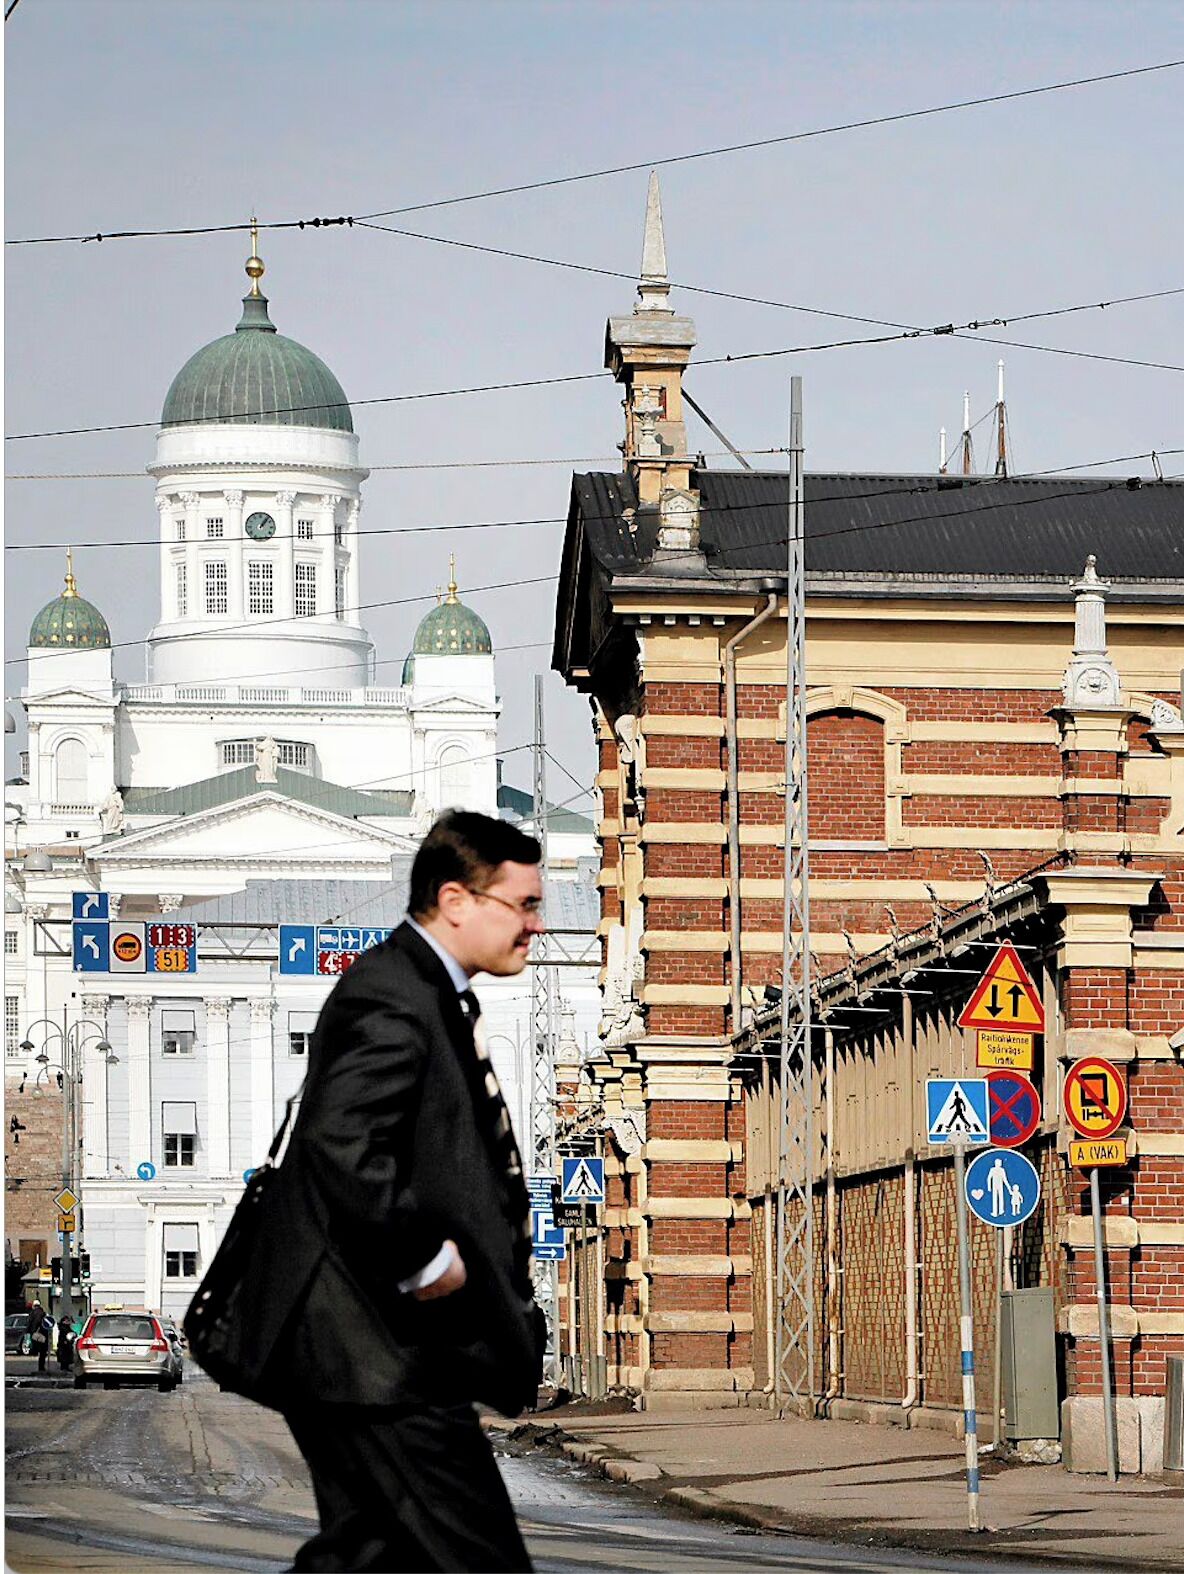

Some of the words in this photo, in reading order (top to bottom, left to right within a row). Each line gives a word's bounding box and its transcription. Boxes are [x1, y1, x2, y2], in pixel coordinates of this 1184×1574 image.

[156, 928, 163, 945] 1
[177, 928, 187, 945] 3
[164, 952, 179, 967] 51
[1077, 1146, 1085, 1161] A
[1089, 1145, 1119, 1160] (VAK)
[537, 1212, 558, 1243] P
